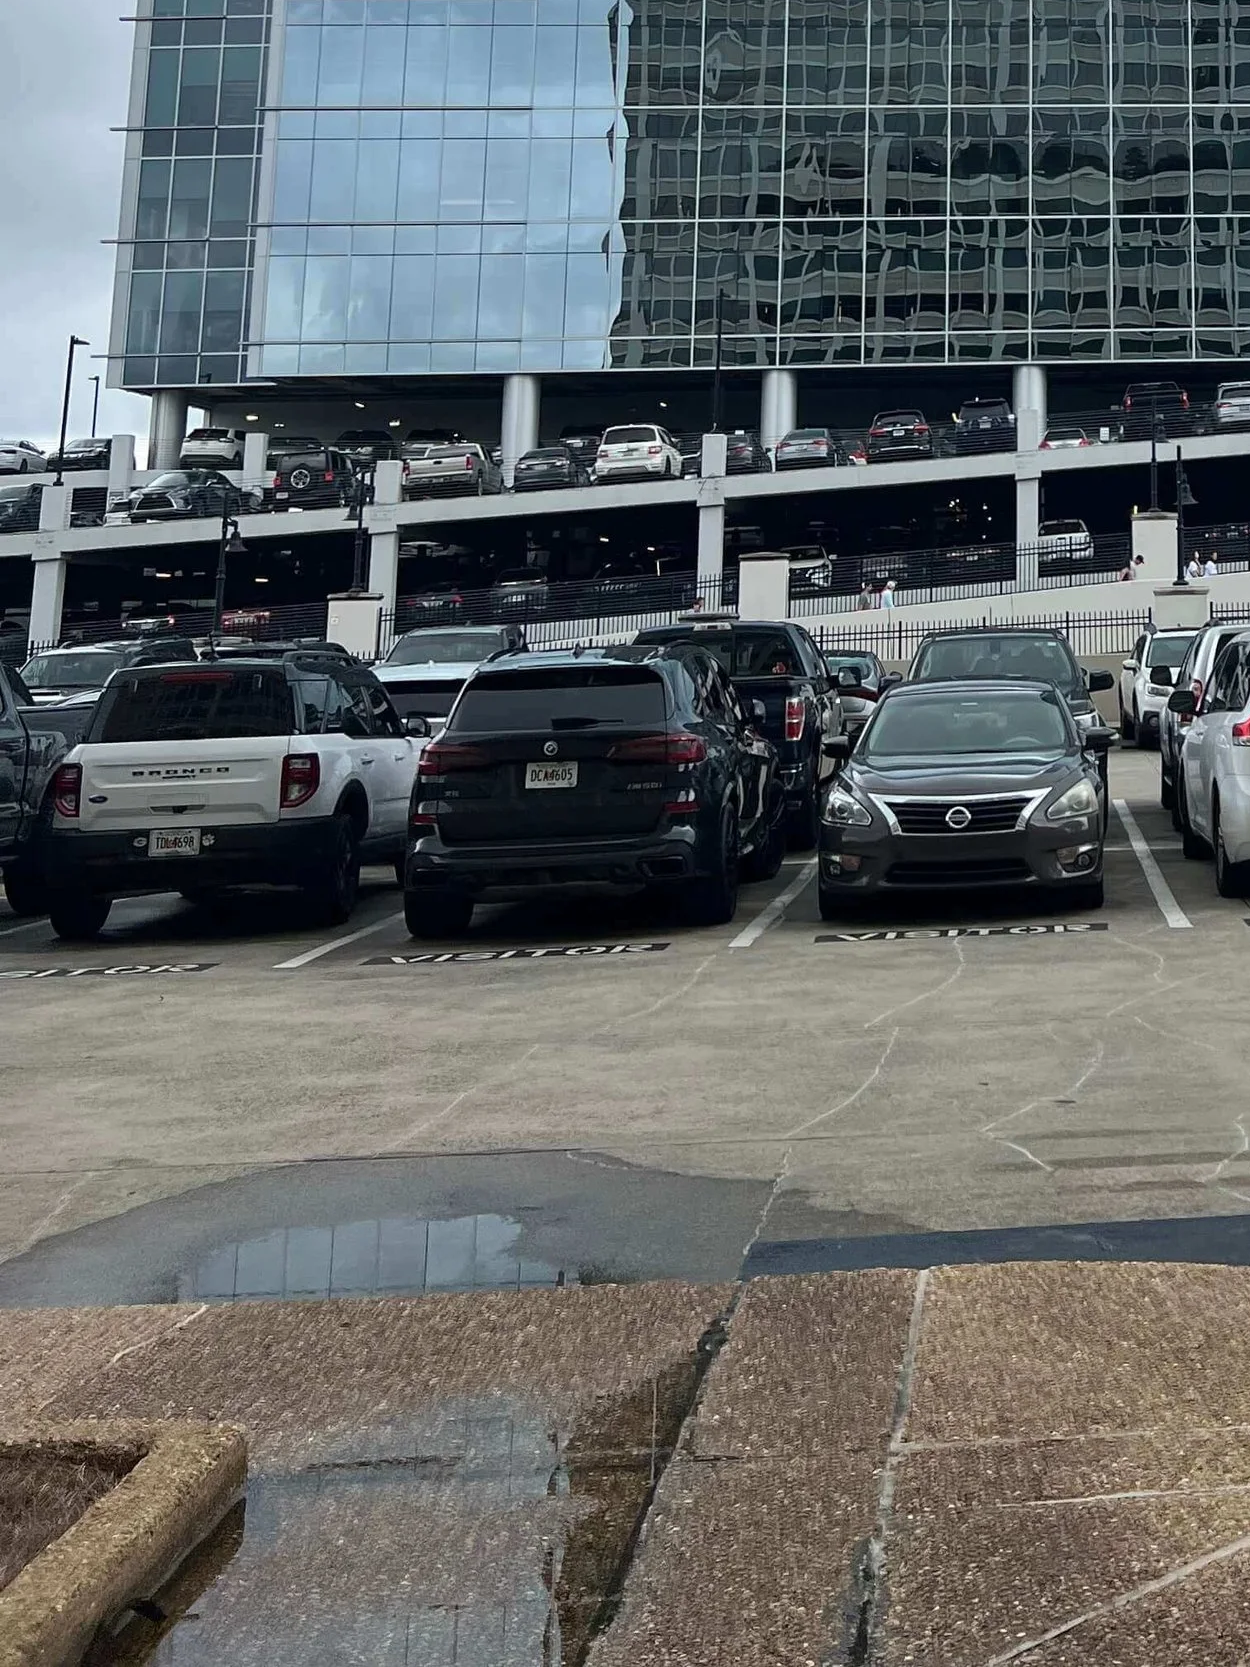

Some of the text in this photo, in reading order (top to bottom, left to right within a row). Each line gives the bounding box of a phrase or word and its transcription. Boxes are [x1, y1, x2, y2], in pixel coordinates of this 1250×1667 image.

[131, 767, 230, 777] BRONCO
[837, 924, 1091, 941] VISITOR
[391, 944, 653, 964] VISITOR
